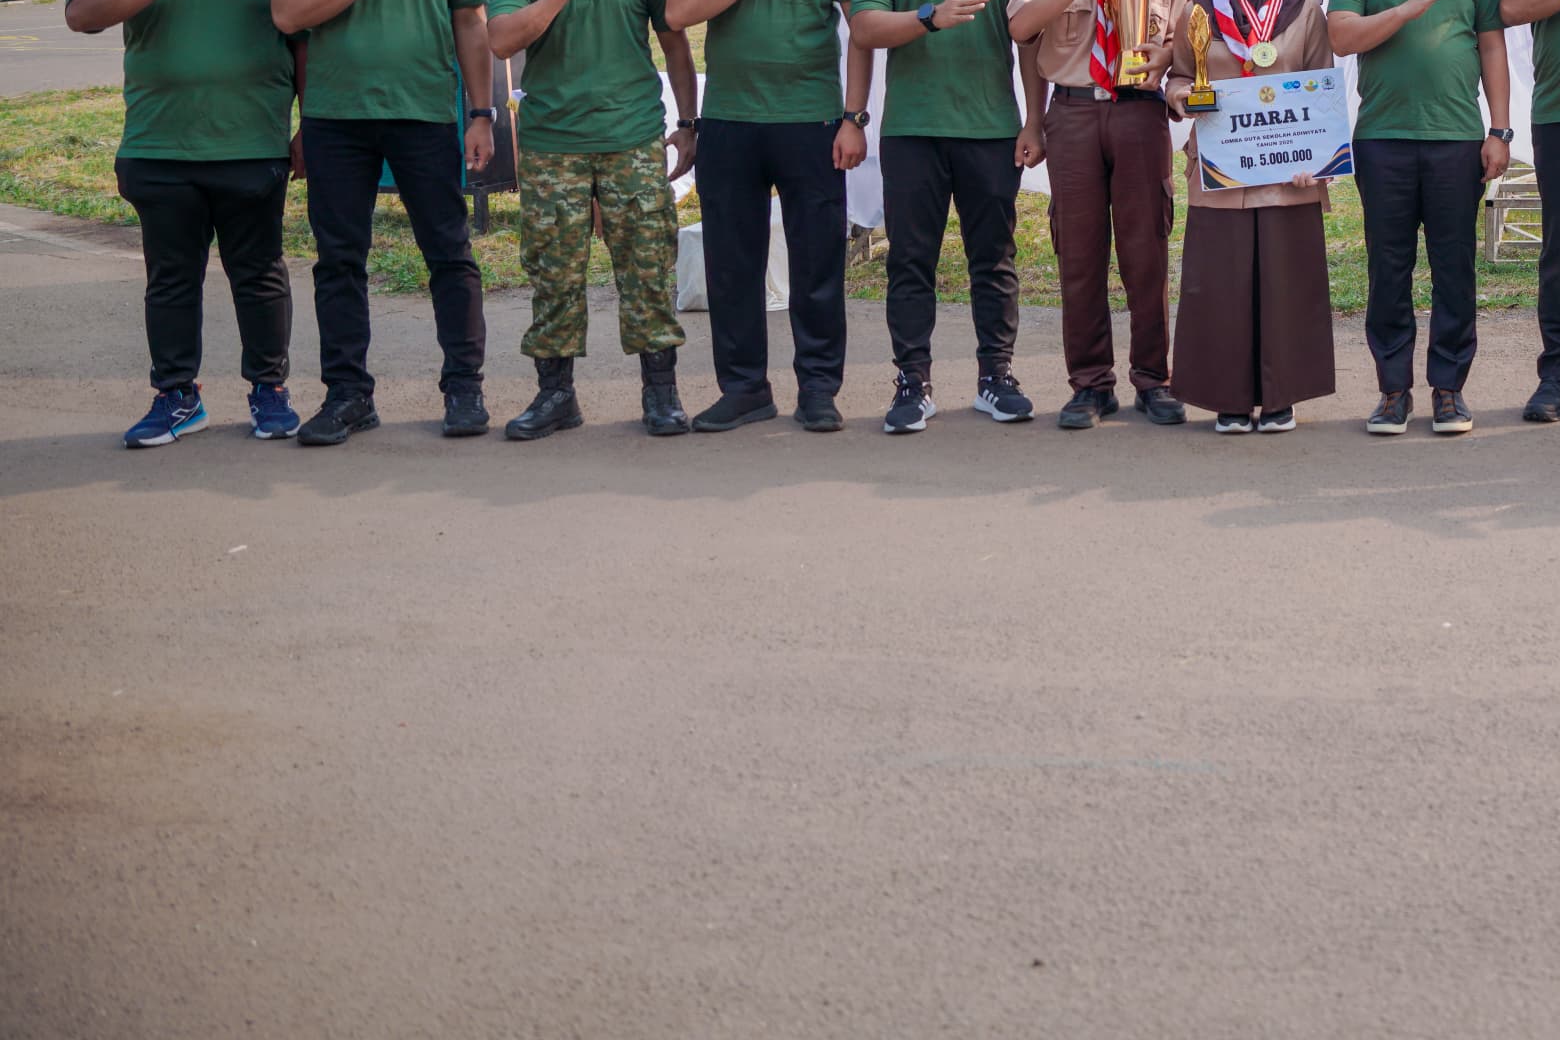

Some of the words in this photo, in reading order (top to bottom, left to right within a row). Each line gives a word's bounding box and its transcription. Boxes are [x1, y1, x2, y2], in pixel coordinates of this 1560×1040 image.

[1230, 109, 1298, 133] JUARA
[1303, 107, 1311, 122] I
[1240, 155, 1257, 170] Rp.
[1259, 148, 1312, 166] 5.000.000
